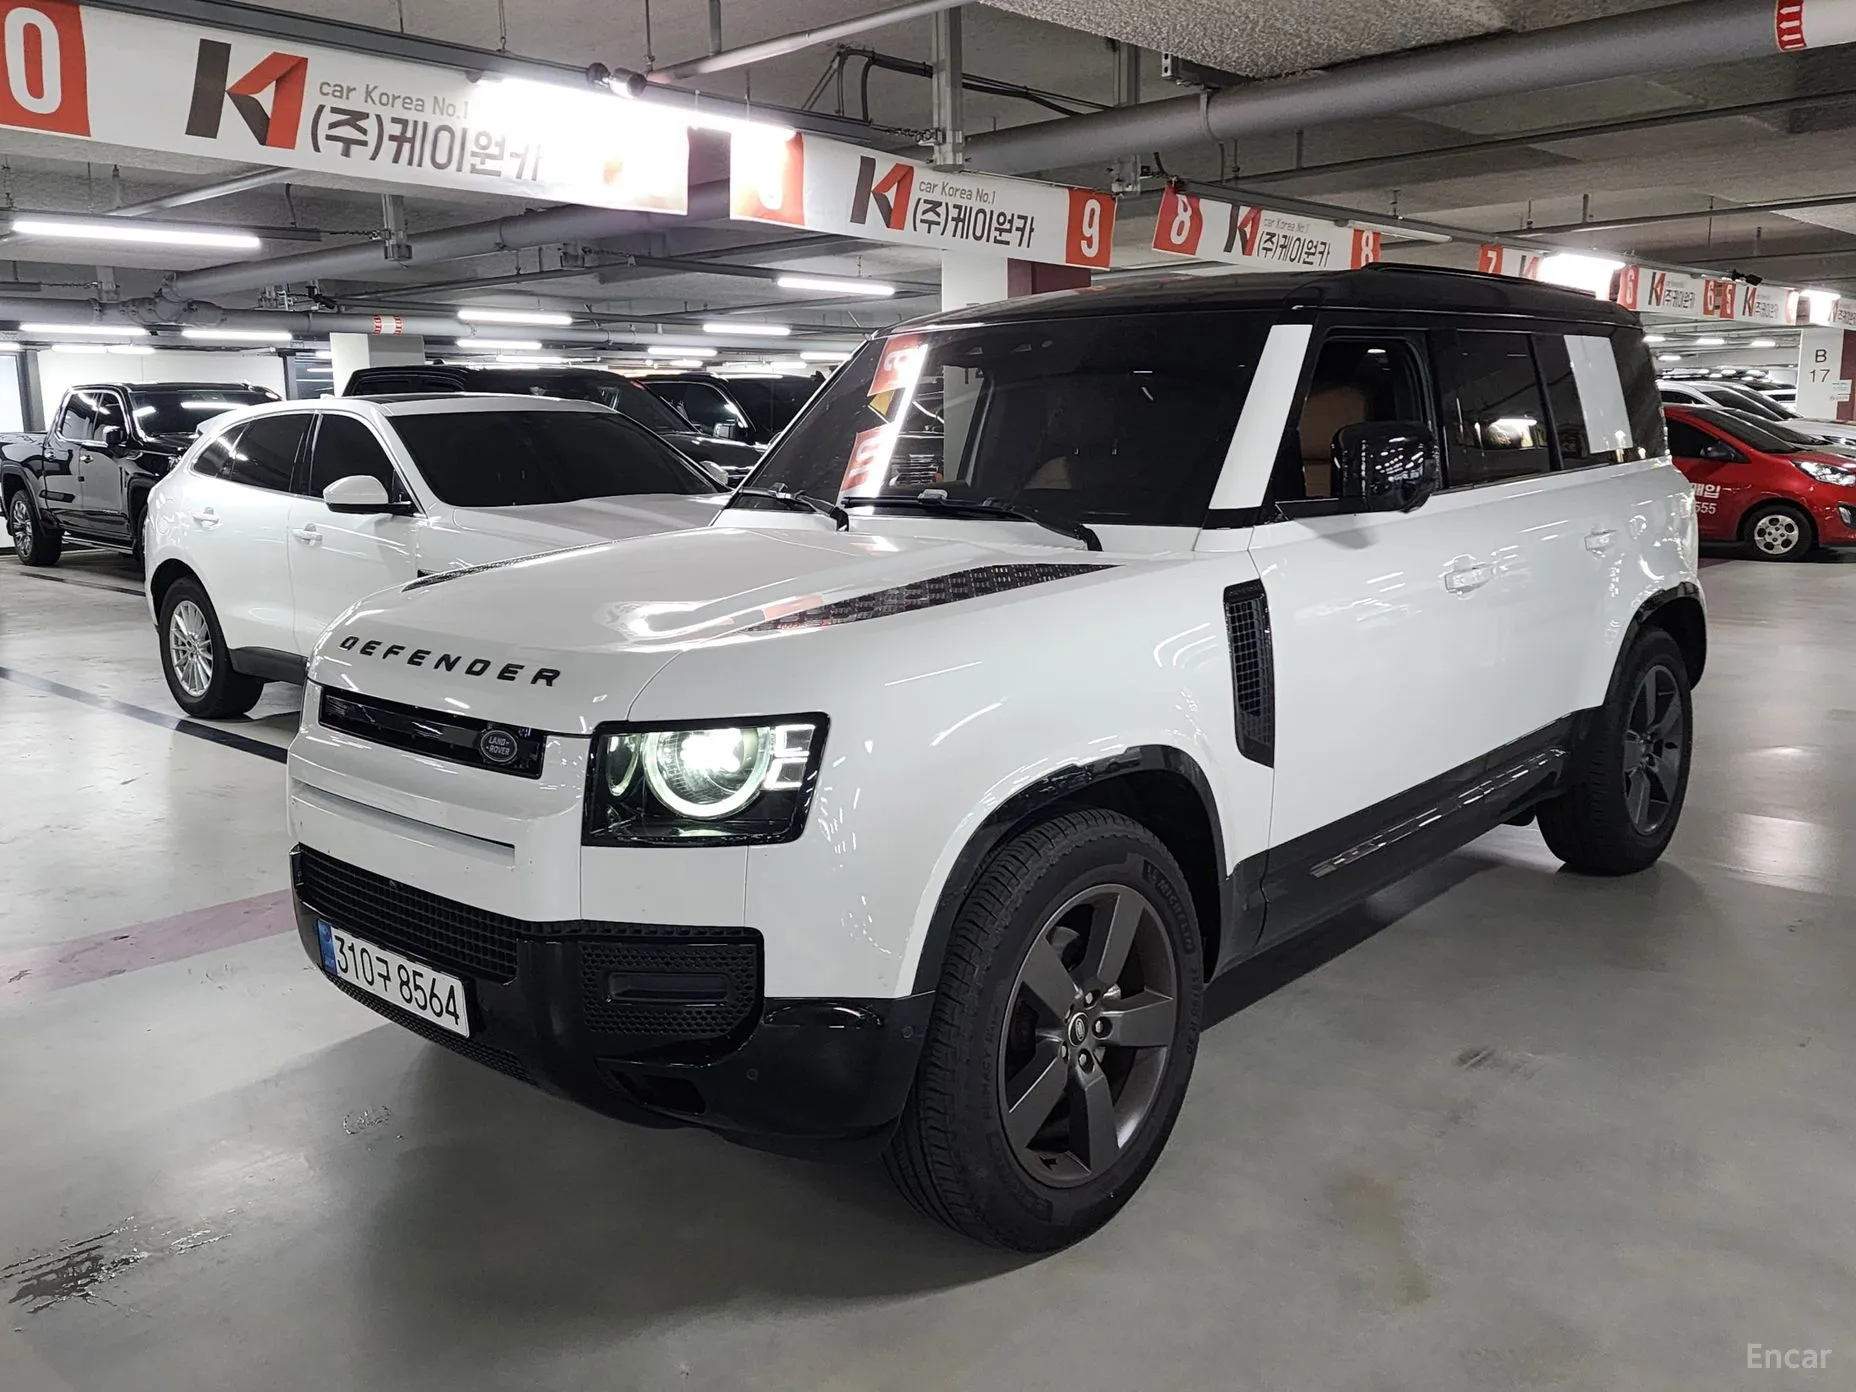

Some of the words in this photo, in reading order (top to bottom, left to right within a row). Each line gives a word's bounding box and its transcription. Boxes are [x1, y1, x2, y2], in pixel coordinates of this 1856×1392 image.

[318, 80, 357, 101] car
[363, 83, 426, 113] Korea
[431, 95, 469, 119] No.1
[310, 103, 544, 183] (주)케이원카
[919, 180, 938, 194] car
[940, 181, 972, 201] Korea
[974, 187, 996, 205] No.1
[912, 197, 1034, 248] (주)케이원카
[1080, 198, 1100, 258] 9
[1170, 193, 1193, 246] 8
[1256, 230, 1331, 268] (주)케이원카
[1361, 230, 1375, 266] 8
[1487, 250, 1497, 273] 7
[1626, 268, 1636, 305] 6
[1707, 280, 1715, 312] 6
[1815, 348, 1827, 363] B
[1809, 368, 1831, 383] 17
[340, 635, 562, 688] DEFENDER
[397, 963, 460, 1026] 8564
